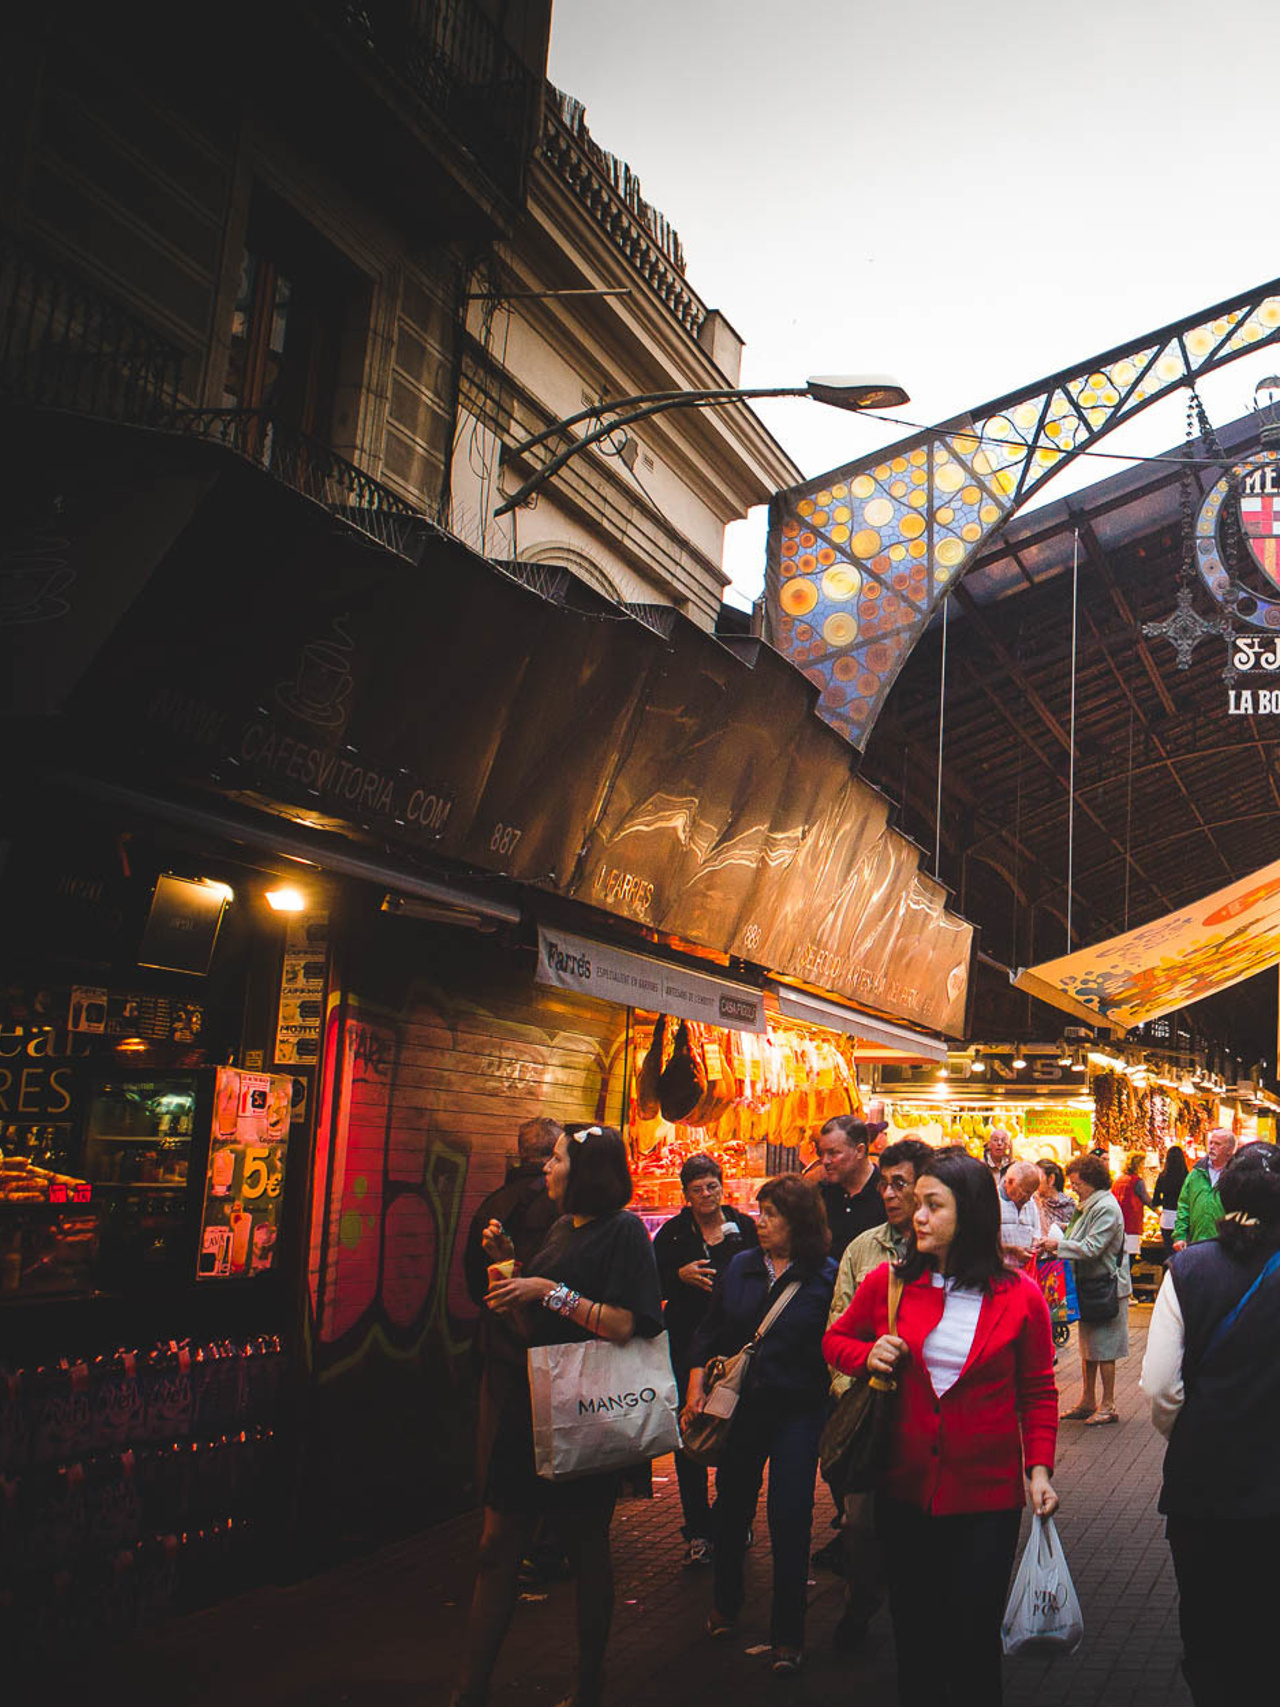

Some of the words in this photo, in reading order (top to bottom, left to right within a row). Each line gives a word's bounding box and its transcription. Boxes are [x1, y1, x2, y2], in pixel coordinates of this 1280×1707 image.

[1229, 690, 1253, 714] LA
[490, 822, 522, 857] 887
[744, 924, 762, 949] 888
[547, 941, 592, 979] Farrés
[1034, 1119, 1071, 1127] TROPICAL
[577, 1386, 658, 1416] MANGO
